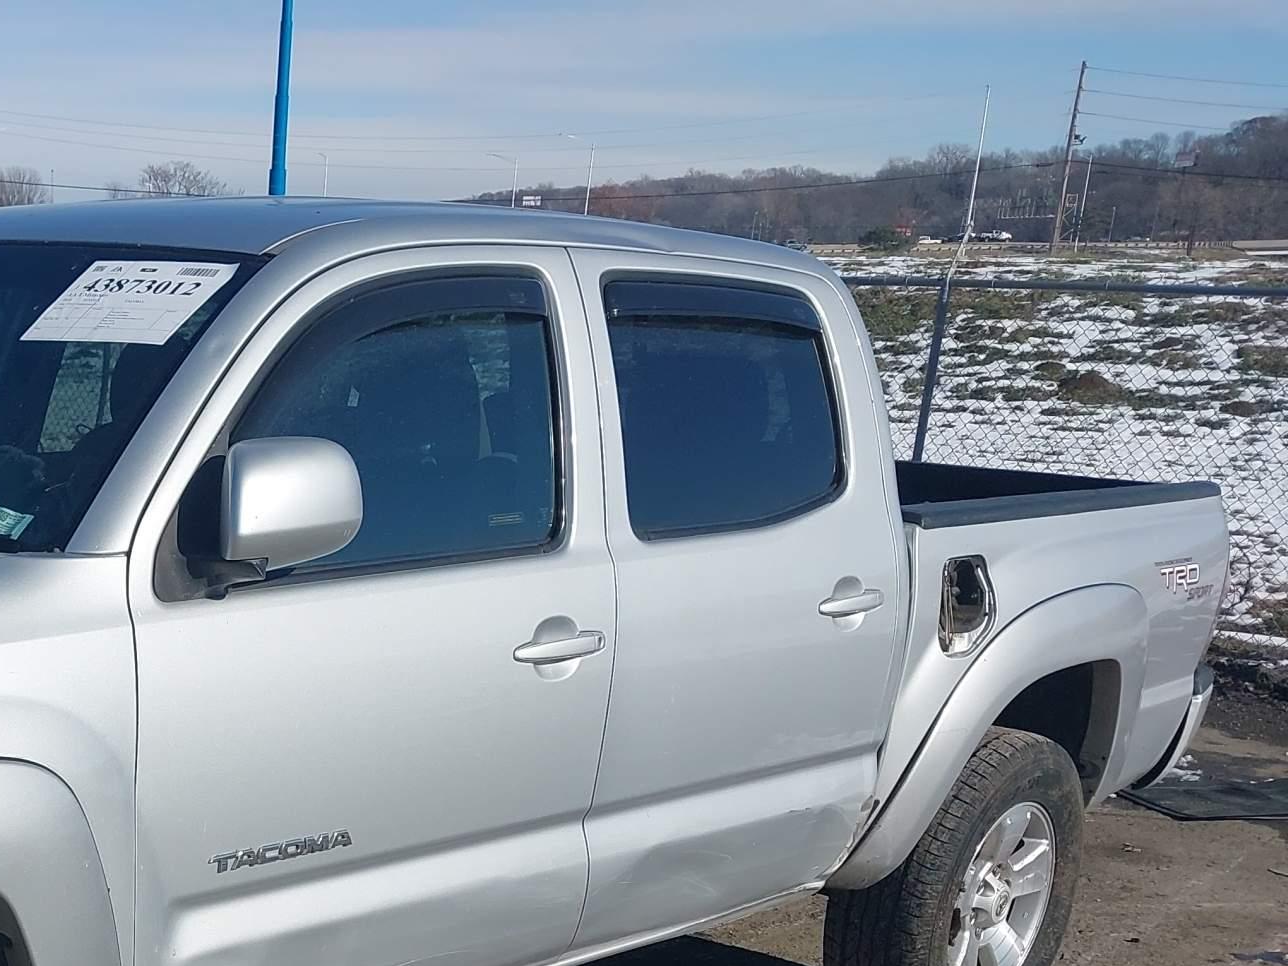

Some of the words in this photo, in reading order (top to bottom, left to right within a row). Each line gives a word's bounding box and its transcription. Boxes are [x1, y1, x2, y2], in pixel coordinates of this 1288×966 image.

[83, 278, 202, 296] 43873012
[1160, 564, 1200, 595] TRD
[208, 828, 352, 873] TACOMA
